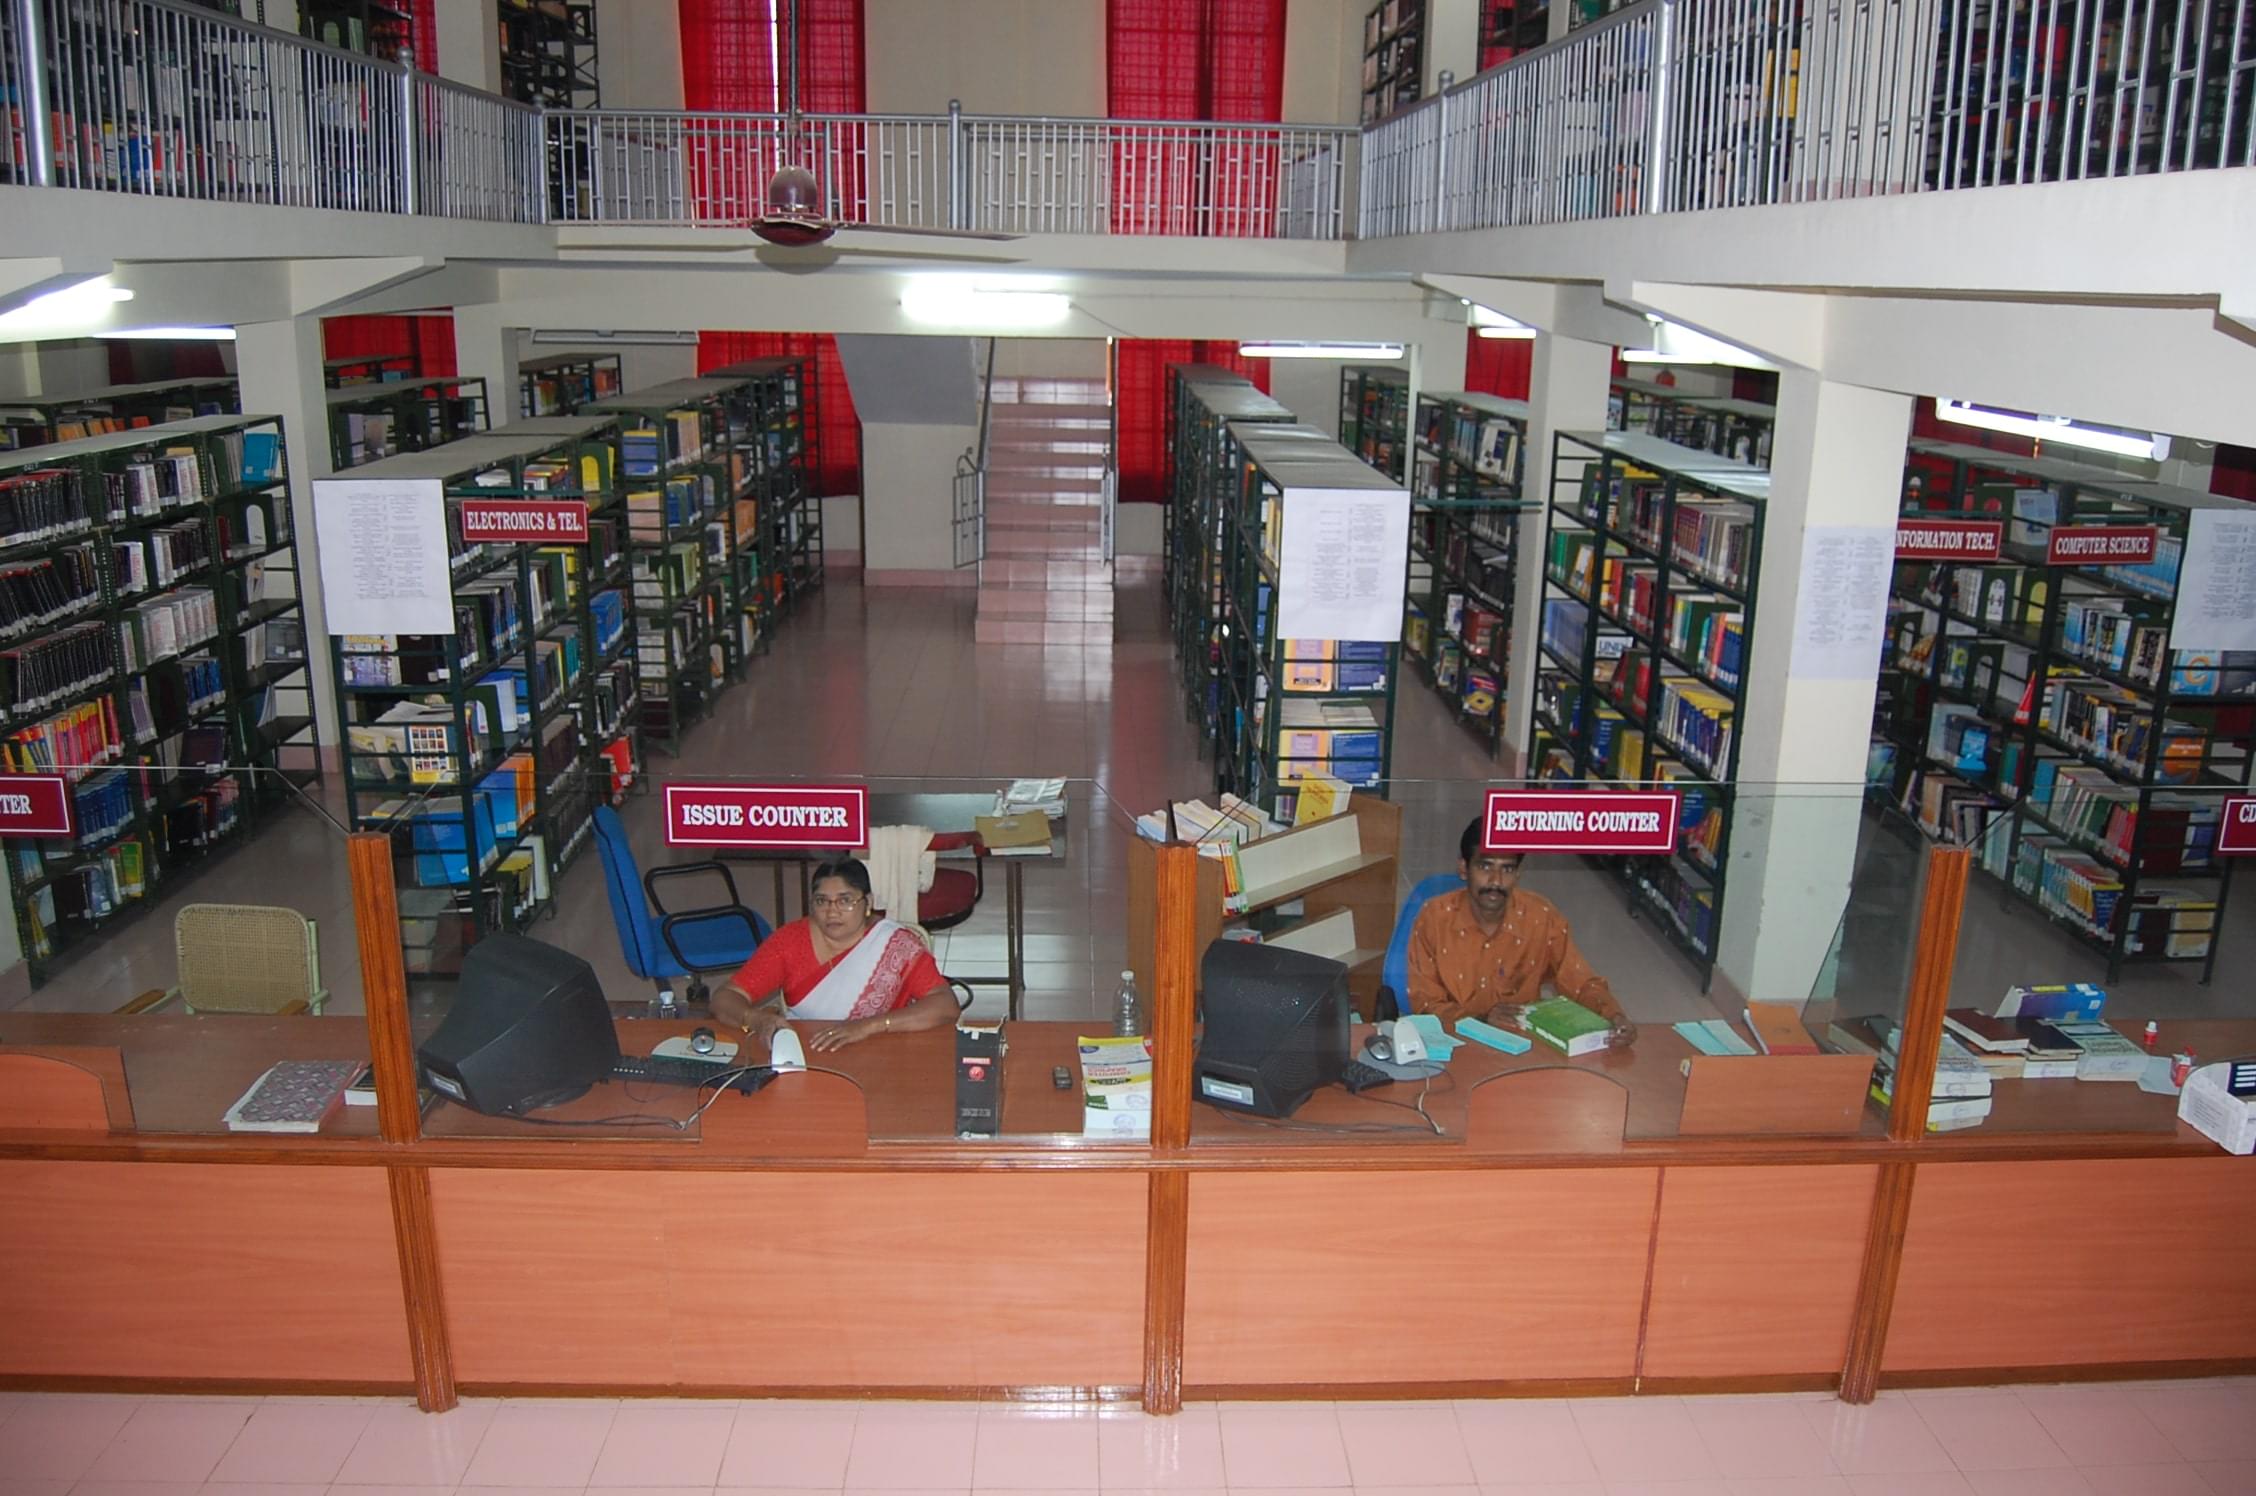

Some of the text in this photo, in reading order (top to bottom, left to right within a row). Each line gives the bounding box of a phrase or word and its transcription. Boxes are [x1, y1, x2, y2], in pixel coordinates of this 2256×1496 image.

[467, 511, 583, 531] ELECTRONICS & TEL.
[1896, 529, 1996, 550] NFORMATION TECH.
[2056, 536, 2149, 555] COMPUTER SCIENCE
[0, 794, 33, 814] TER
[682, 804, 849, 827] ISSUE COUNTER
[1495, 810, 1660, 833] RETURNING COUNTER
